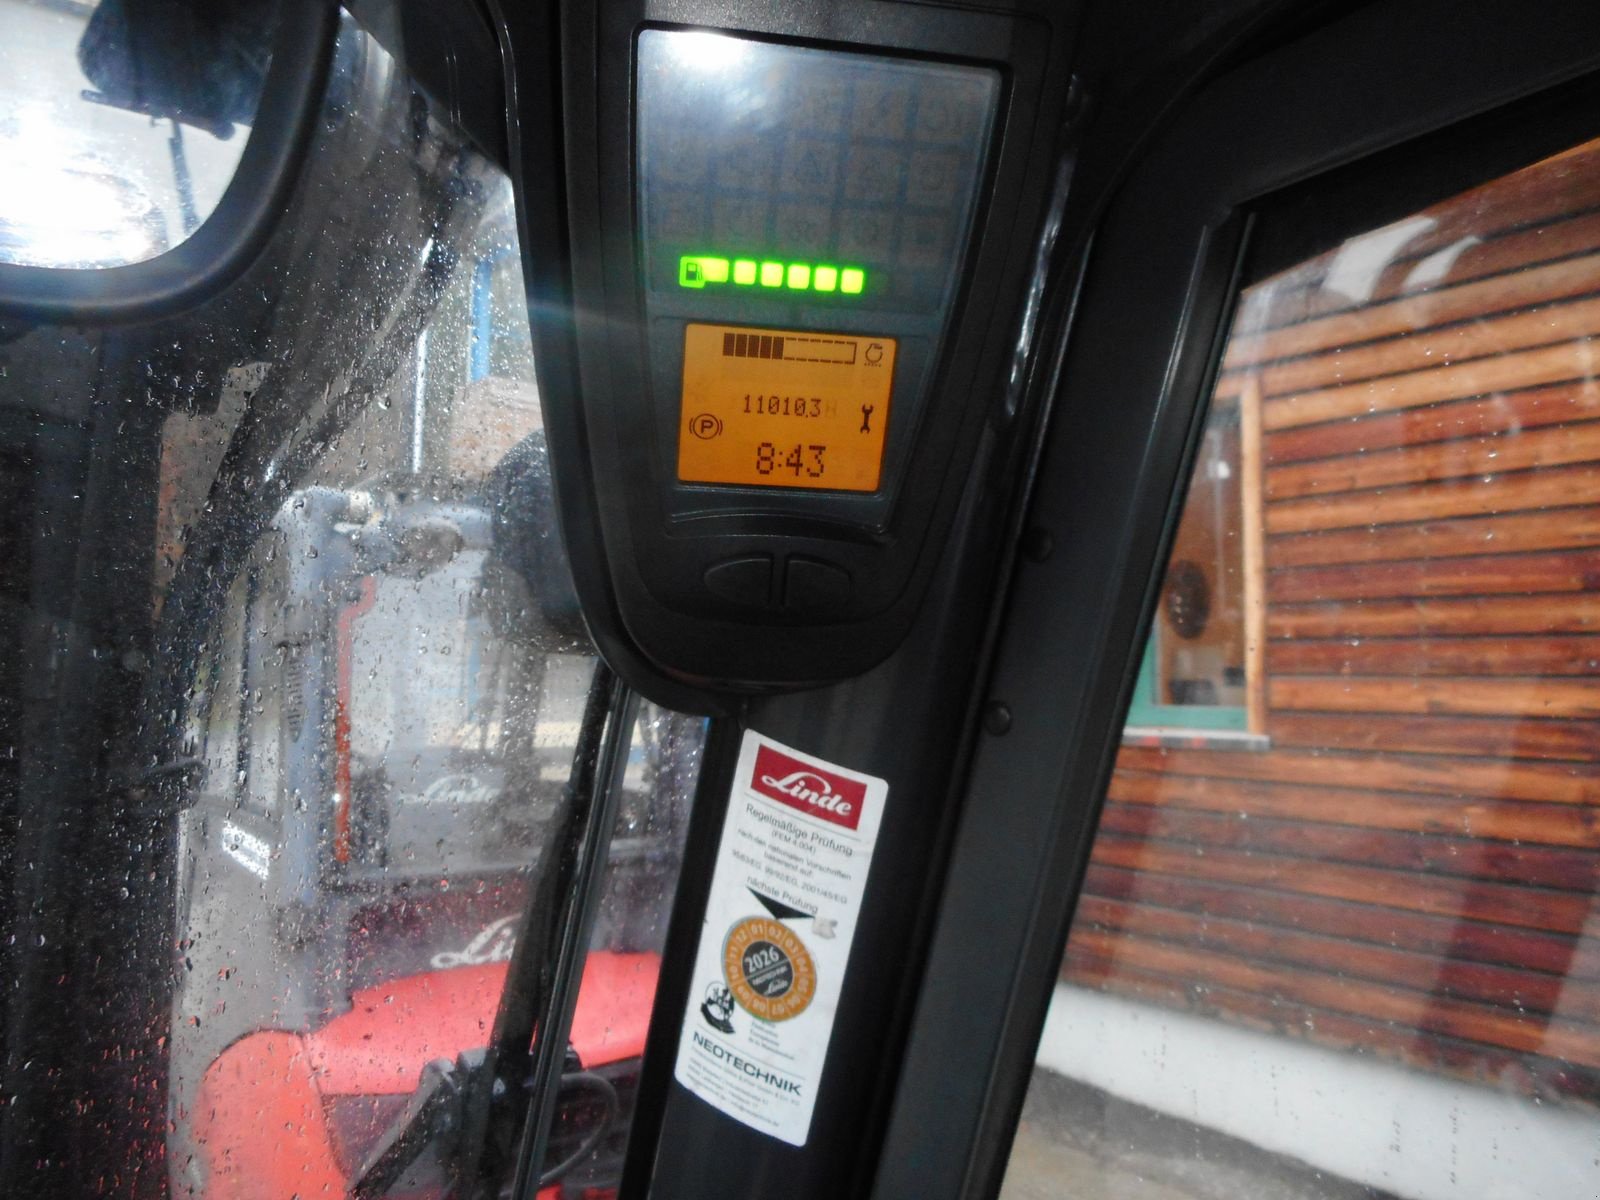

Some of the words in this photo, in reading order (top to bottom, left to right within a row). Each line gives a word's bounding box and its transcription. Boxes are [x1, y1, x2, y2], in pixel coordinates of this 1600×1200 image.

[755, 442, 827, 478] 8:43
[761, 771, 852, 816] Linde
[745, 802, 809, 841] Regelmäßige
[811, 832, 854, 857] Prüfung
[782, 890, 819, 914] Prüfung
[744, 946, 780, 974] 2026
[693, 1031, 802, 1097] NEOTECHNIK
